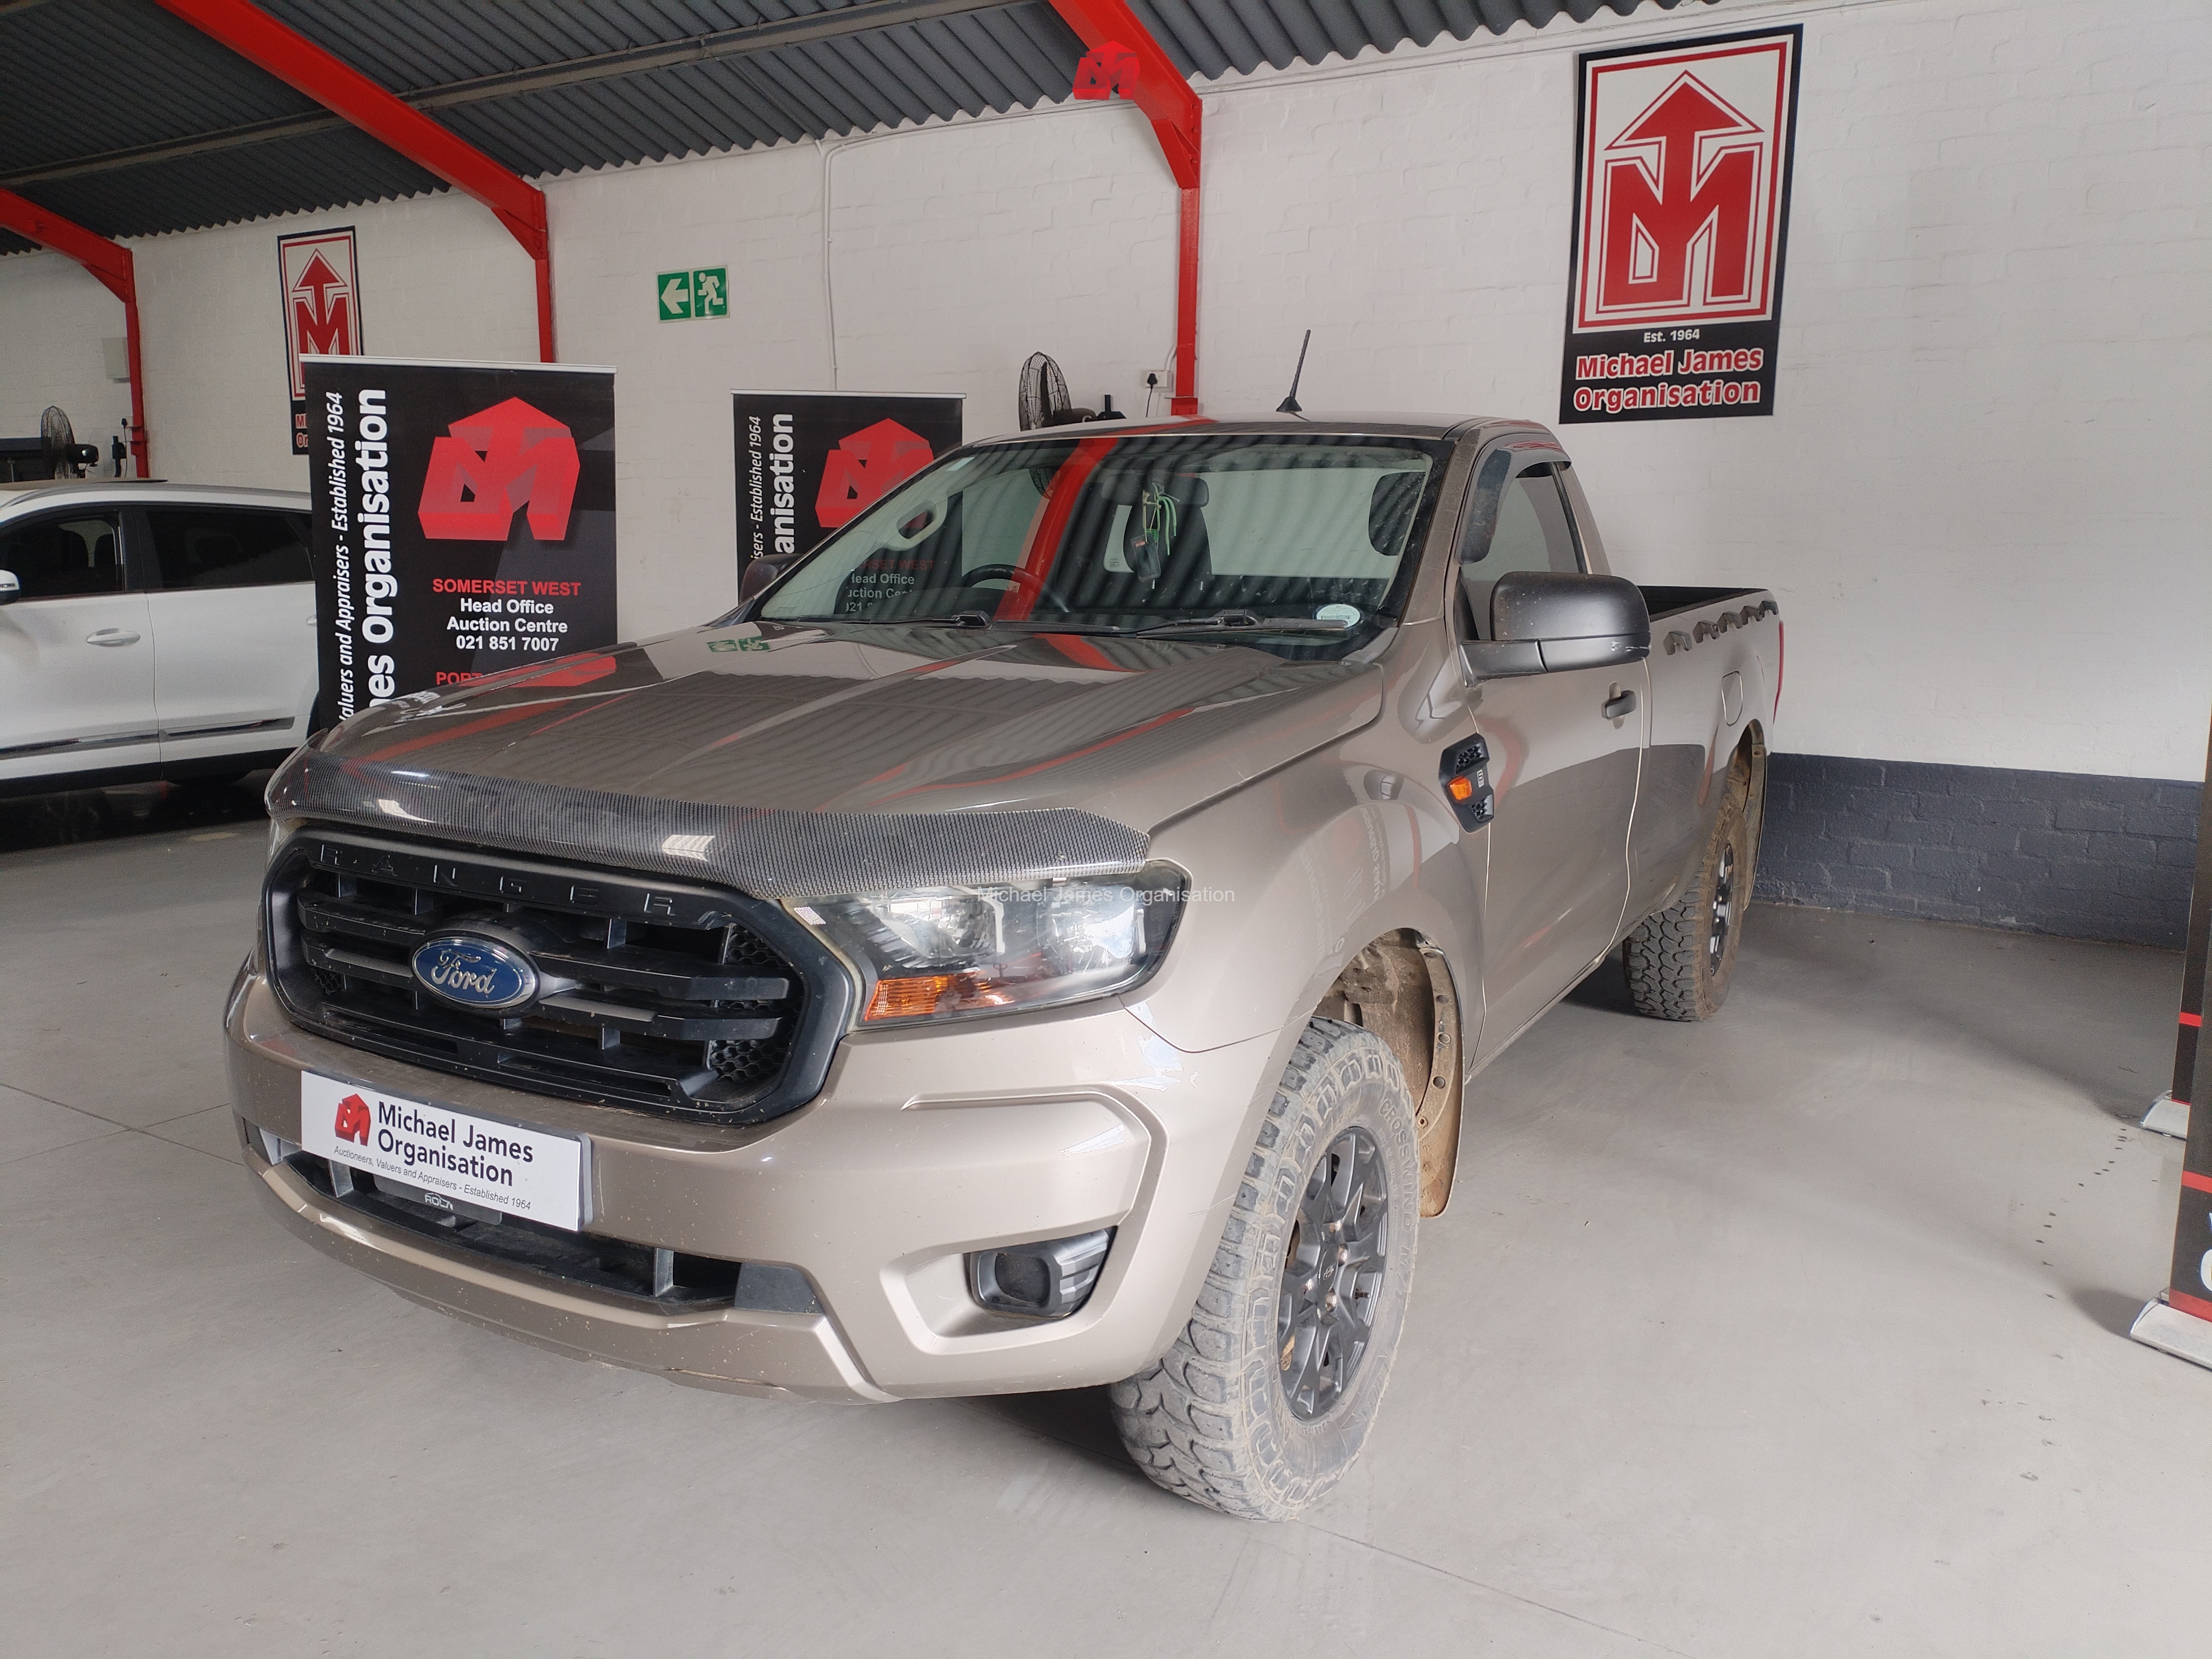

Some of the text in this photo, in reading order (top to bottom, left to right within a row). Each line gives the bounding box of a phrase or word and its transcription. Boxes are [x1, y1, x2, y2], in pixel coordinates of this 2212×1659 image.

[1643, 328, 1701, 343] Est. 1964
[1575, 348, 1764, 380] Michael James
[326, 392, 345, 433] 1964
[1573, 379, 1762, 414] Organisation
[748, 415, 761, 447] 1964
[326, 436, 348, 531] Established
[748, 450, 763, 522] Established
[768, 413, 795, 554] anisation
[335, 544, 355, 631] Appraisers
[433, 578, 582, 596] SOMERSET WEST
[880, 573, 915, 585] Office
[446, 616, 568, 633] Auction Centre
[460, 597, 554, 615] Head Office
[334, 632, 353, 666] and
[456, 635, 559, 651] 021 851 7007
[320, 844, 675, 916] RANGER
[431, 949, 497, 995] Ford
[379, 1101, 534, 1163] Michael James
[334, 1145, 374, 1167] Auctioneers,
[376, 1158, 402, 1175] Valuers
[403, 1168, 417, 1179] and
[417, 1171, 457, 1191] Appraisers
[464, 1184, 509, 1205] Established
[511, 1197, 531, 1211] 1964
[378, 1128, 512, 1187] Organisation
[1378, 1098, 1418, 1232] CROSSWIND
